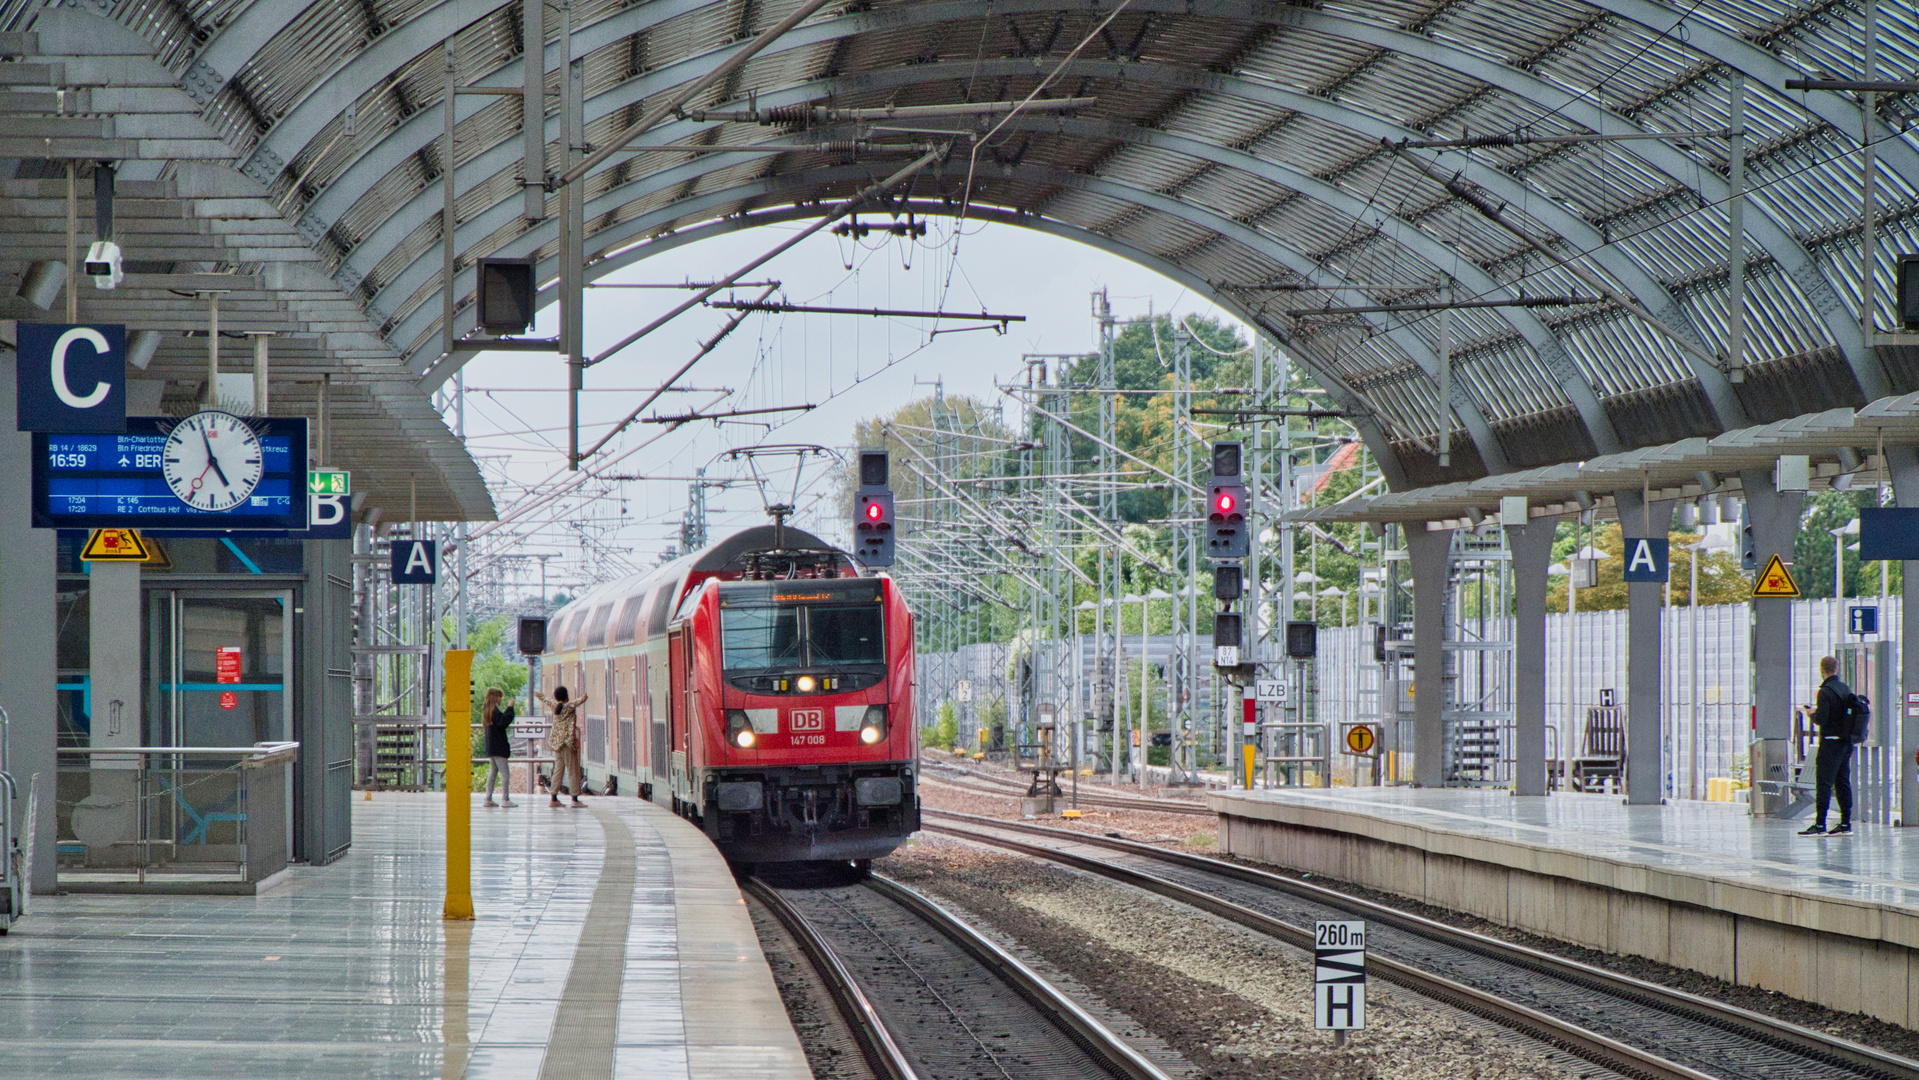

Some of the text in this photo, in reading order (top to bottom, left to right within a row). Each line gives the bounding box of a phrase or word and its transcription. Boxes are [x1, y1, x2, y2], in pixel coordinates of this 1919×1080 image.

[50, 326, 112, 409] C
[48, 444, 58, 452] RB
[61, 444, 68, 452] 14
[77, 444, 97, 452] 18629
[117, 444, 129, 452] Bln
[49, 454, 162, 468] 16:59 BER
[68, 505, 86, 513] 17:20
[117, 505, 126, 513] RE
[128, 505, 133, 513] 2
[310, 495, 345, 526] B
[404, 541, 432, 575] A
[1628, 539, 1656, 572] A
[1258, 684, 1286, 697] LZB
[1600, 690, 1614, 706] H
[793, 711, 820, 729] DB
[790, 735, 825, 745] 147 008
[1317, 924, 1363, 946] 260 m
[1326, 985, 1354, 1027] H
